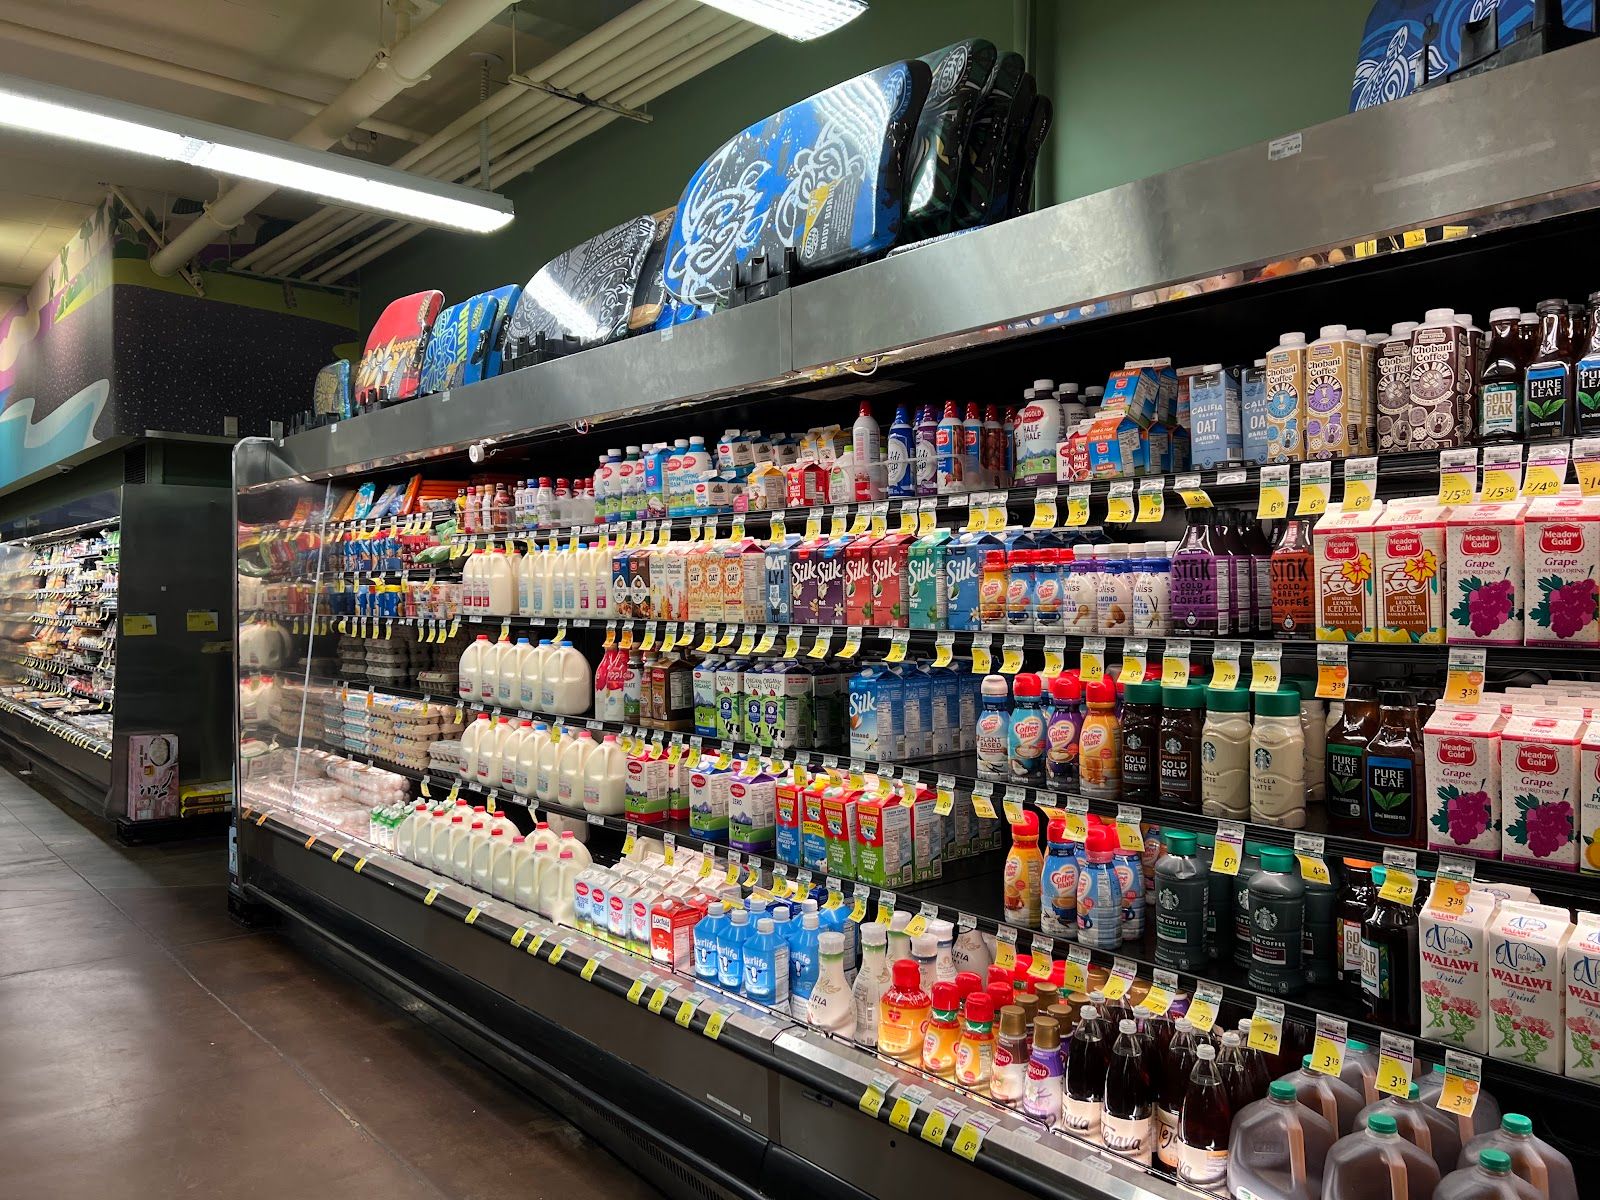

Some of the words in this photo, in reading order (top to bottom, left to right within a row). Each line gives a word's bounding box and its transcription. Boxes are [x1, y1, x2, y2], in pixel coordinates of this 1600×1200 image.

[824, 185, 836, 220] BOARD
[820, 223, 831, 251] BODY
[456, 303, 470, 363] ALOHA
[1412, 343, 1454, 355] Chobani
[1416, 352, 1449, 363] Coffee
[1308, 357, 1341, 370] Chobani
[1268, 365, 1296, 378] Chobani
[1311, 366, 1336, 378] Coffee
[1270, 375, 1293, 385] Coffee
[1531, 379, 1562, 392] PURE
[1531, 388, 1561, 398] LEAF
[1486, 393, 1513, 406] GOLD
[1192, 404, 1223, 418] CALIFIA
[1486, 404, 1513, 419] PEAK
[1196, 420, 1218, 434] OAT
[1194, 434, 1220, 444] BARISTA
[1073, 461, 1088, 470] HALF
[1465, 533, 1497, 543] Meadow
[1545, 530, 1579, 540] Meadow
[1328, 541, 1355, 550] Meadow
[1390, 537, 1418, 547] Meadow
[1471, 541, 1490, 549] Gold
[1550, 537, 1572, 546] Gold
[1333, 547, 1350, 555] Gold
[1395, 544, 1413, 552] Gold
[1465, 559, 1495, 570] Grape
[1544, 557, 1578, 569] Grape
[792, 560, 819, 586] Silk
[817, 559, 843, 586] Silk
[845, 558, 871, 585] Silk
[872, 556, 899, 586] Silk
[908, 557, 937, 587] Silk
[945, 556, 979, 588] Silk
[1482, 568, 1502, 576] DRINK
[690, 574, 701, 582] OAT
[709, 574, 719, 582] OAT
[728, 573, 739, 582] OAT
[768, 570, 785, 585] LY!
[1174, 595, 1212, 605] COFFEE
[1272, 599, 1309, 607] COFFEE
[1344, 604, 1359, 612] TEA
[1408, 604, 1423, 612] TEA
[762, 677, 782, 685] ORGANIC
[850, 691, 878, 718] Silk
[1015, 722, 1040, 734] Coffee
[1021, 729, 1038, 737] mate
[1049, 729, 1070, 740] Coffee
[1081, 729, 1102, 742] Coffee
[980, 741, 1002, 749] BASED
[1084, 738, 1101, 747] mate
[1441, 743, 1471, 754] Meadow
[1125, 755, 1146, 764] COLD
[1447, 750, 1466, 759] Gold
[1520, 751, 1554, 763] Meadow
[1161, 760, 1187, 769] COLD
[1332, 755, 1358, 766] PURE
[1527, 758, 1547, 768] Gold
[1125, 763, 1147, 772] BREW
[1161, 768, 1188, 778] BREW
[1332, 762, 1357, 774] LEAF
[1374, 768, 1405, 779] PURE
[1442, 768, 1471, 783] Grape
[1374, 777, 1405, 788] LEAF
[1521, 776, 1553, 789] Grape
[1051, 872, 1075, 885] Coffee
[1165, 917, 1187, 927] COFFEE
[1346, 930, 1360, 943] GO
[1261, 938, 1286, 948] COFFEE
[1436, 971, 1464, 985] Drink
[1507, 989, 1536, 1004] Drink
[1101, 1121, 1142, 1151] Tejava
